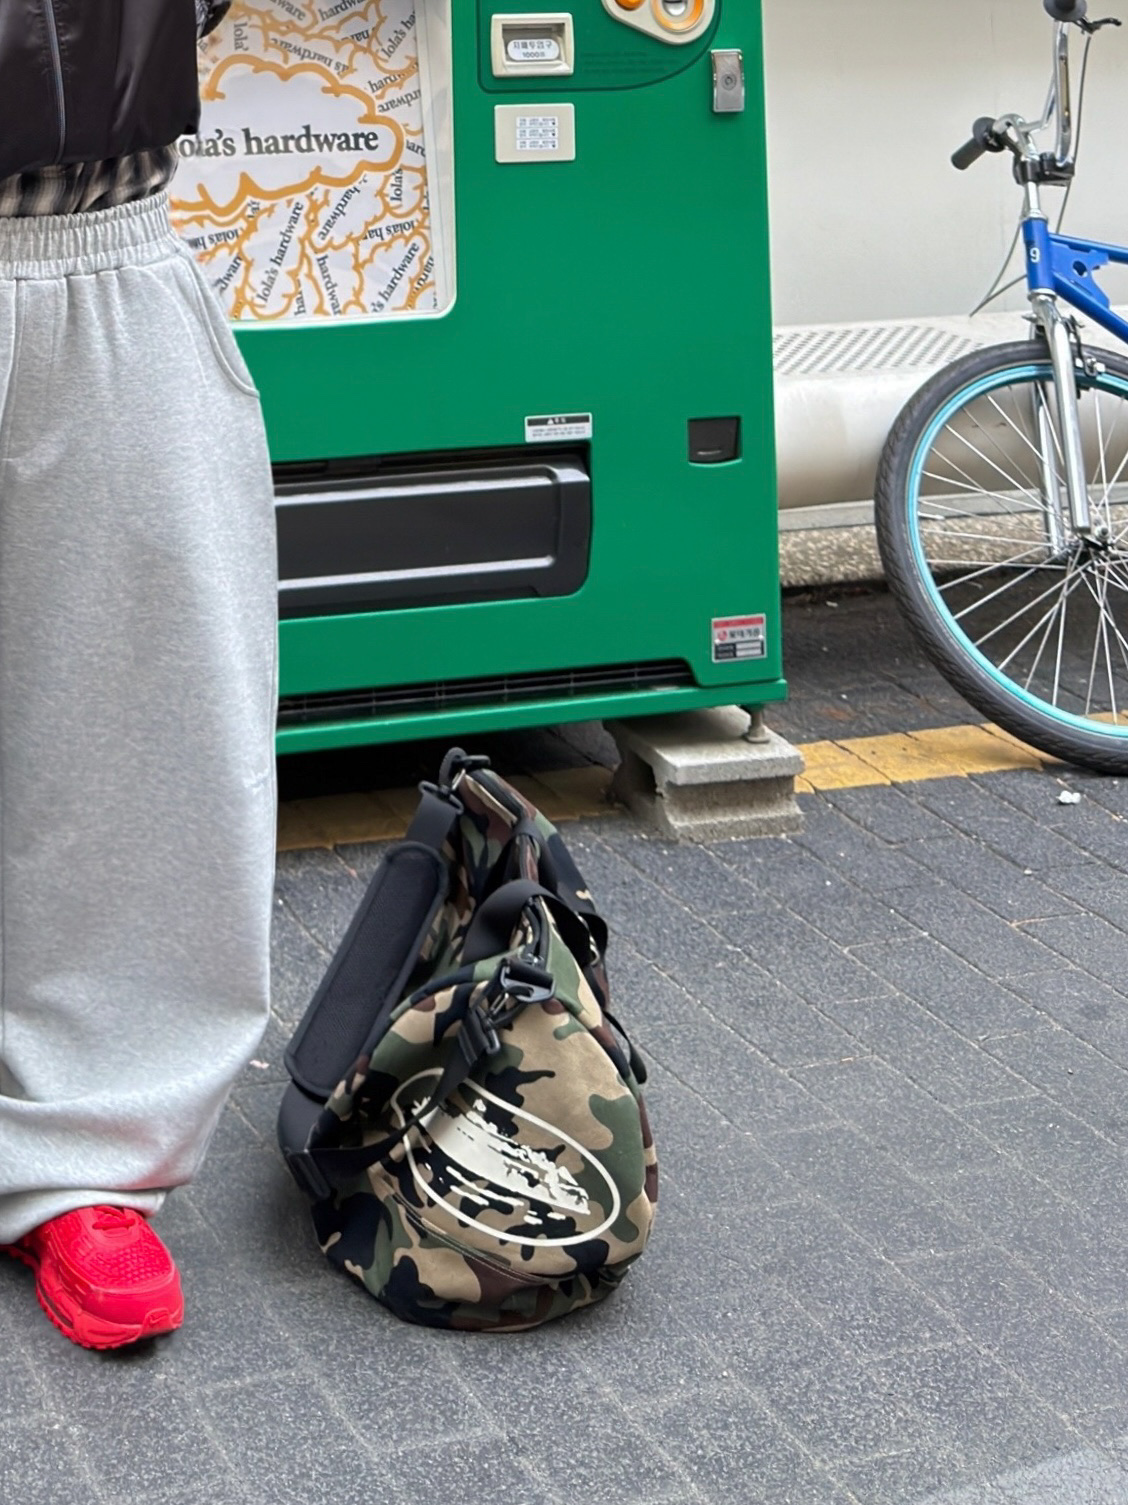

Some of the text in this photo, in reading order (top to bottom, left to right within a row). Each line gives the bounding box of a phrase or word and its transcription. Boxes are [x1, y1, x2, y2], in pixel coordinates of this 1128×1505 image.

[178, 124, 379, 157] ola's hardware
[256, 201, 304, 303] lola's hardware
[381, 242, 420, 303] hardware
[1030, 247, 1041, 264] 9
[317, 254, 341, 316] hardwar
